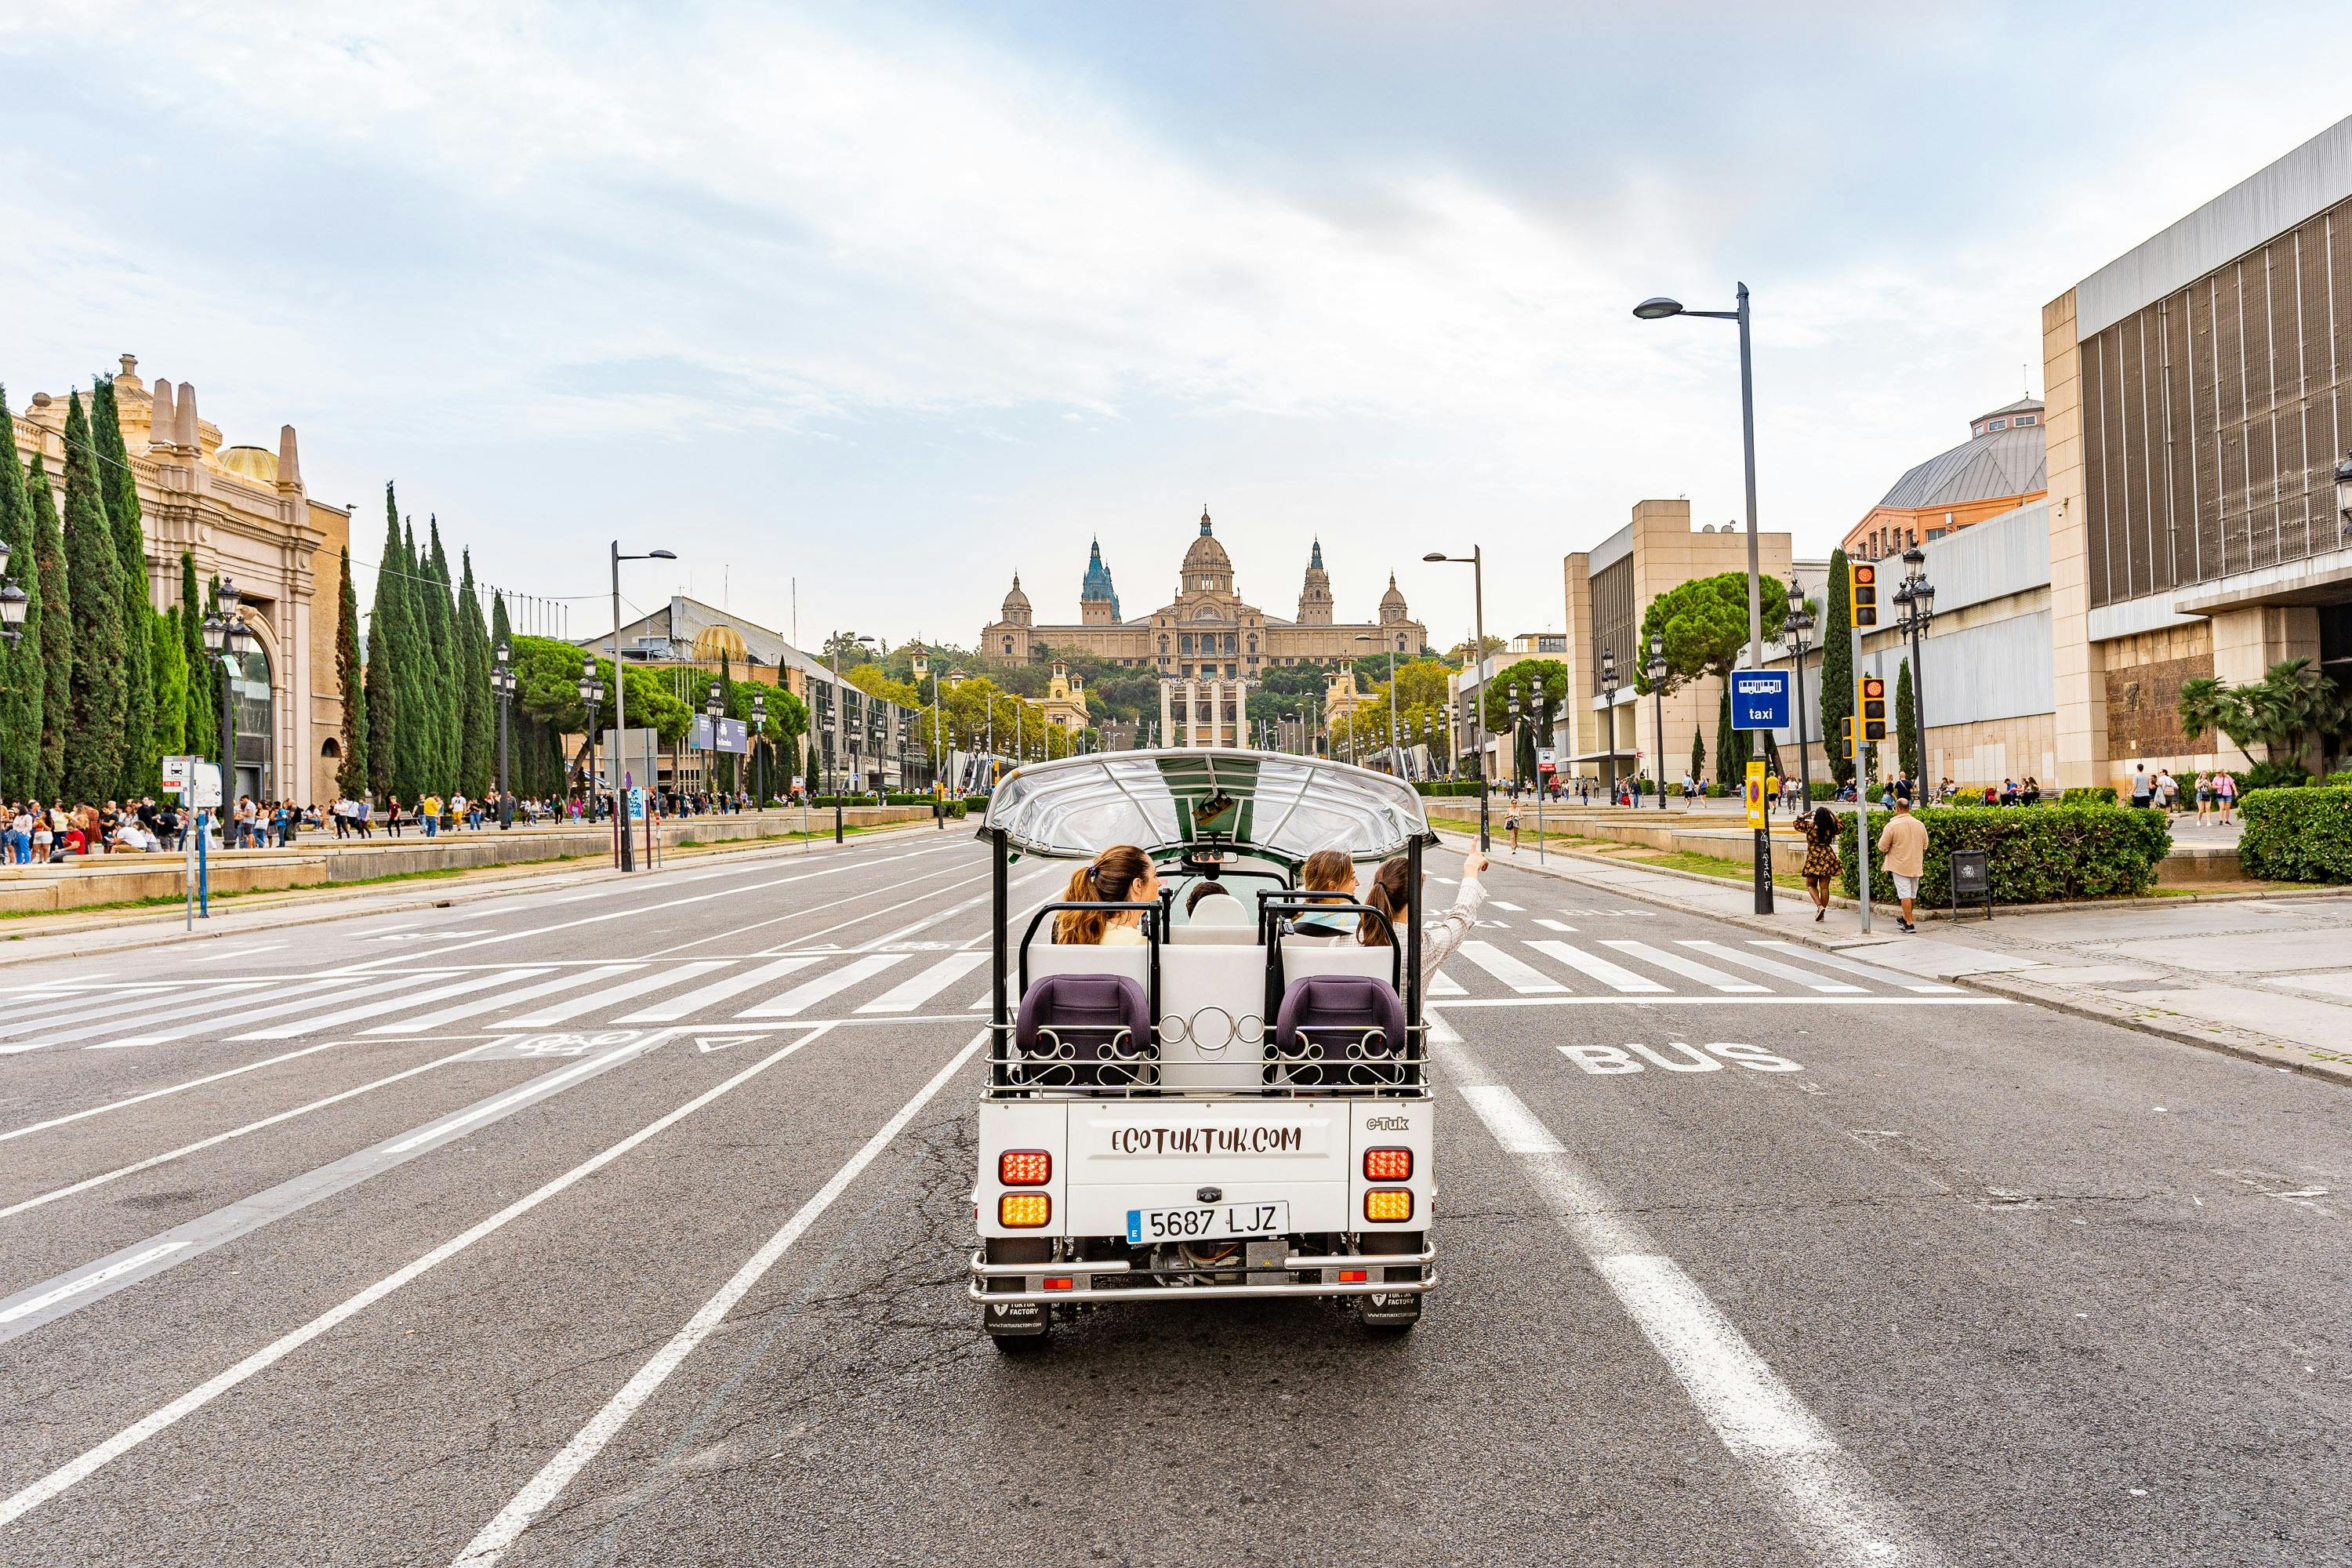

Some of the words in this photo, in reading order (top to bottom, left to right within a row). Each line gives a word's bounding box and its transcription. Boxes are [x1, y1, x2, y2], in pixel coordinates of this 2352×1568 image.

[1749, 708, 1773, 720] taxi
[1555, 1042, 1806, 1075] BUS
[1367, 1116, 1410, 1131] e-Tuk
[1150, 1210, 1215, 1237] 5687
[1229, 1206, 1276, 1233] LJZ
